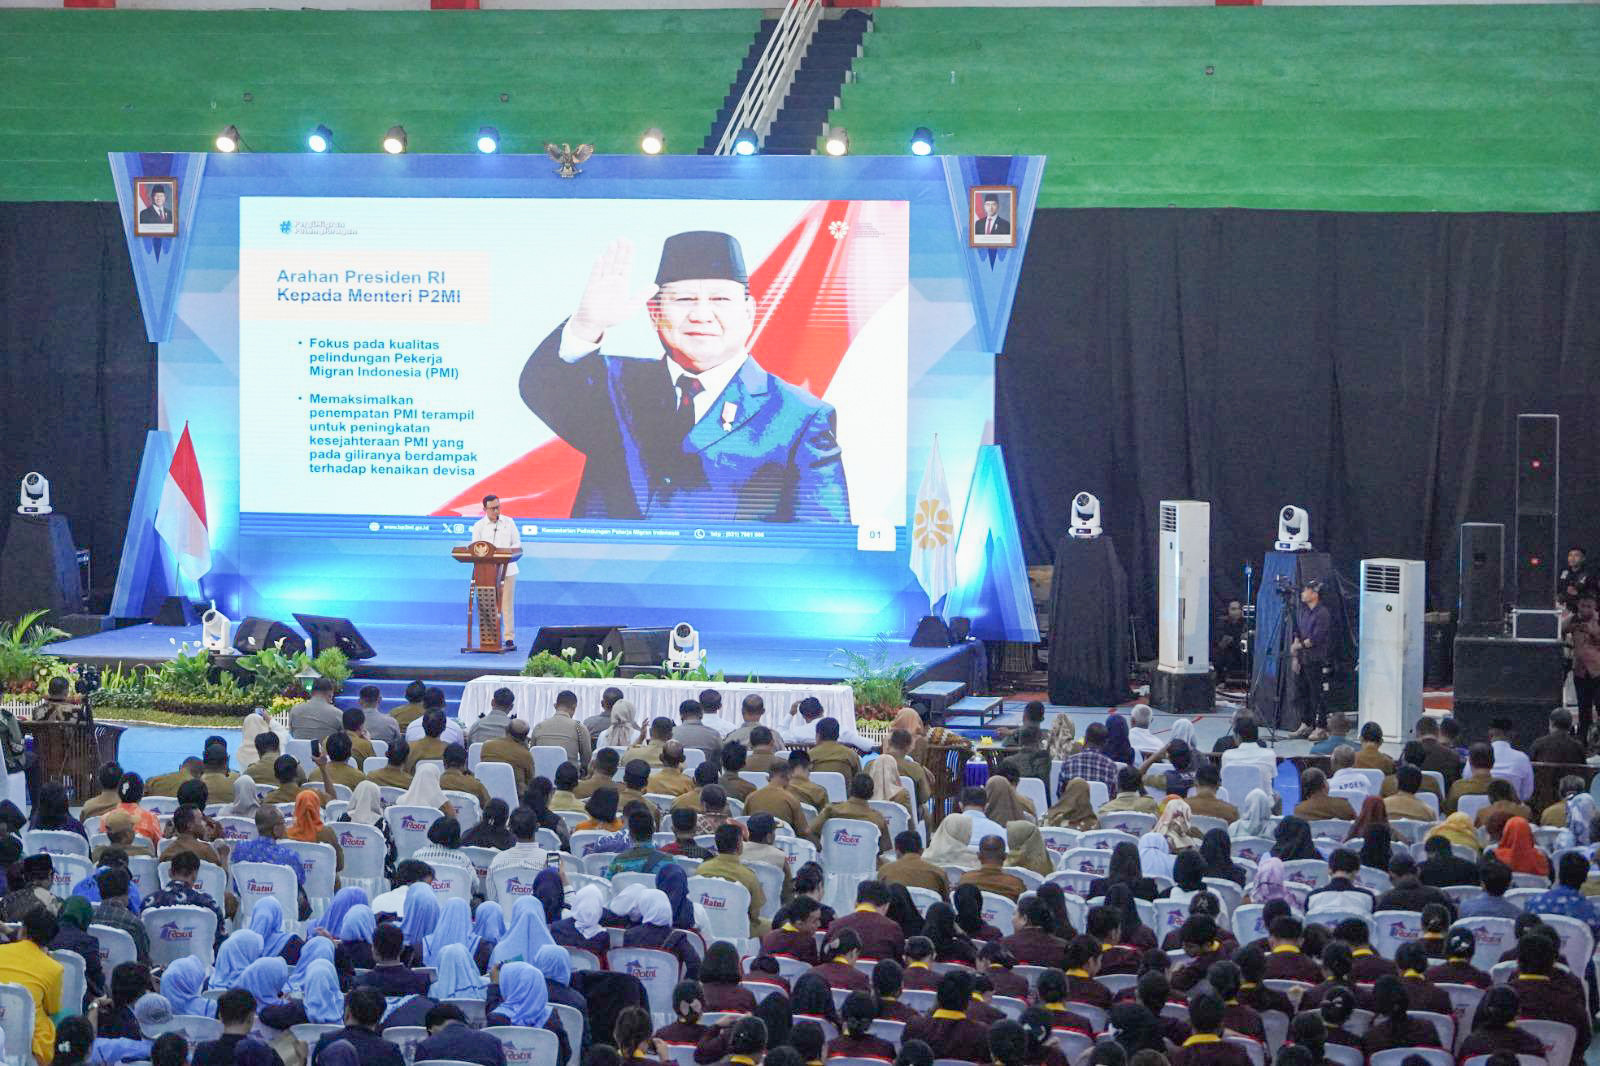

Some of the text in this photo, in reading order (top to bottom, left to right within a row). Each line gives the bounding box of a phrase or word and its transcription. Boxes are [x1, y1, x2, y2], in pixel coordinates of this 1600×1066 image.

[277, 270, 445, 284] Arahan Presiden RI
[277, 288, 461, 304] Kepada Menteri P2MI
[310, 338, 440, 351] Fokus pada kualitas
[309, 352, 443, 365] pelindungan Pekerja
[309, 366, 459, 380] Migran Indonesia (PMI)
[309, 394, 414, 405] Memaksimalkan
[309, 408, 474, 422] penempatan PMI terampil
[309, 422, 430, 435] untuk peningkatan
[309, 436, 464, 450] kesejahteraan PMI yang
[309, 450, 478, 463] pada giliranya berdampak
[309, 464, 475, 476] terhadap kenaikan devisa
[869, 530, 881, 539] 01
